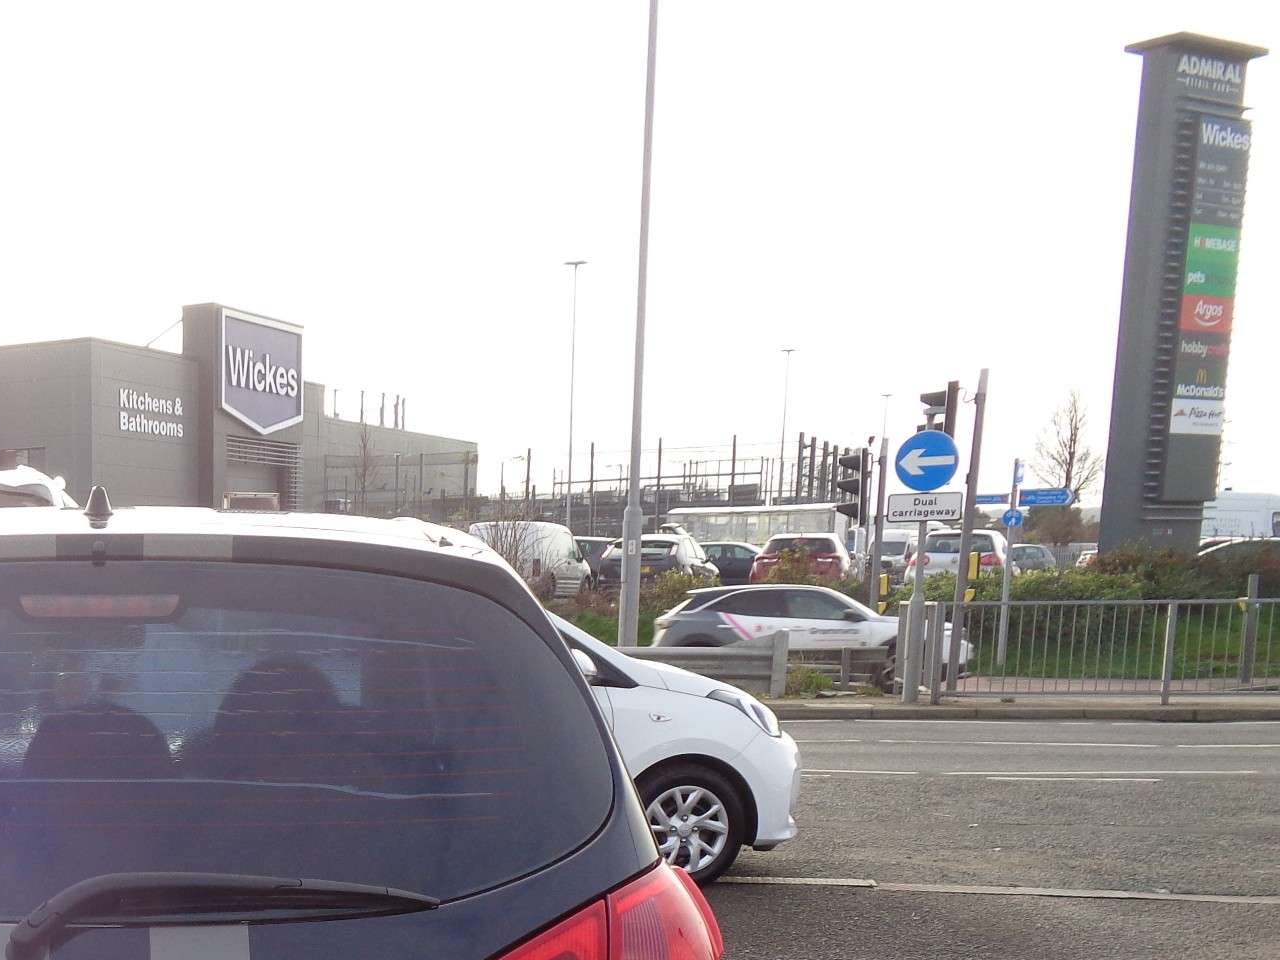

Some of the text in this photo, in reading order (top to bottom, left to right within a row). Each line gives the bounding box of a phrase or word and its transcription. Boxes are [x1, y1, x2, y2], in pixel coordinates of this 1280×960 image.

[1178, 54, 1241, 83] ADMIRAL
[1202, 122, 1249, 150] Wickes
[1194, 299, 1223, 319] Argos
[228, 344, 298, 398] Wickes
[120, 388, 183, 416] Kitchens &
[1177, 384, 1224, 398] McDonald's
[120, 411, 184, 437] Bathrooms
[892, 507, 957, 518] carriageway
[913, 497, 937, 507] Dual
